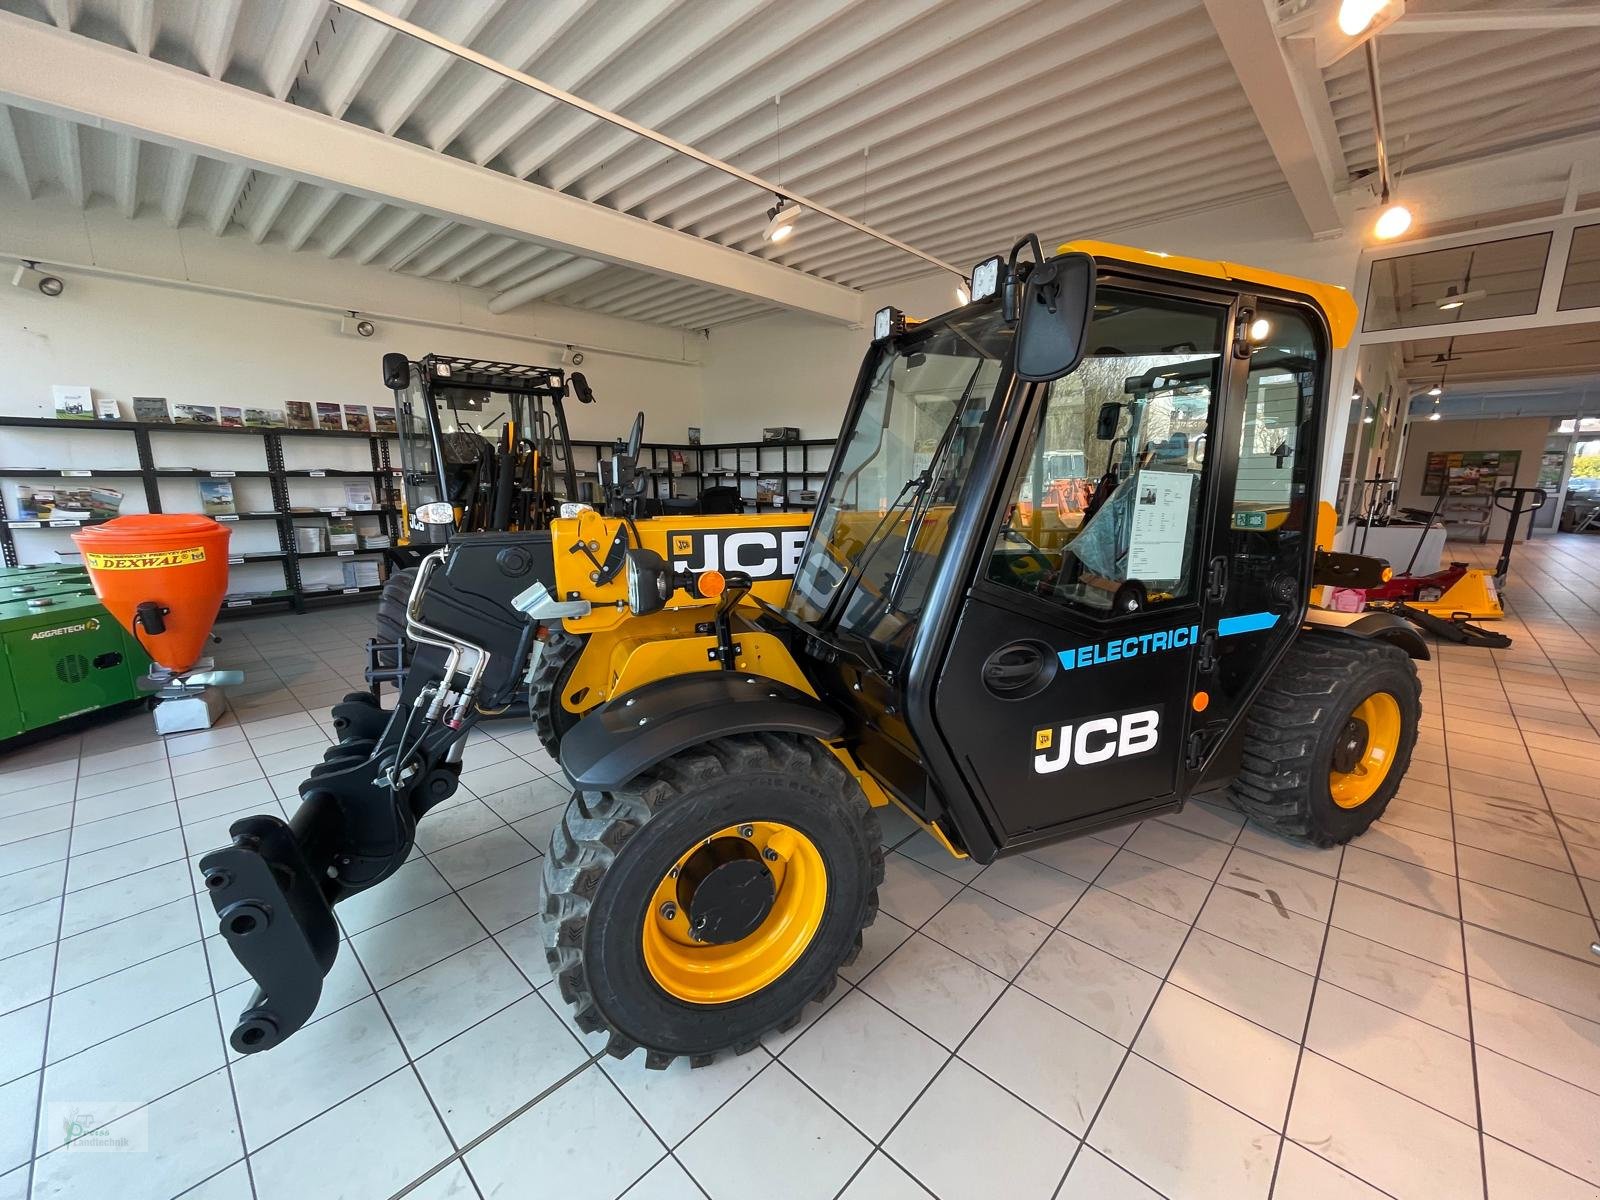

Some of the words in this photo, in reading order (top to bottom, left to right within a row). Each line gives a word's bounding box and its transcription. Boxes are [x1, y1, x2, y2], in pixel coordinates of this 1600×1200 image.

[103, 555, 183, 569] DEXWAL
[31, 624, 86, 641] AGGRETECH
[1077, 627, 1190, 668] ELECTRIC
[1034, 709, 1160, 775] JCB
